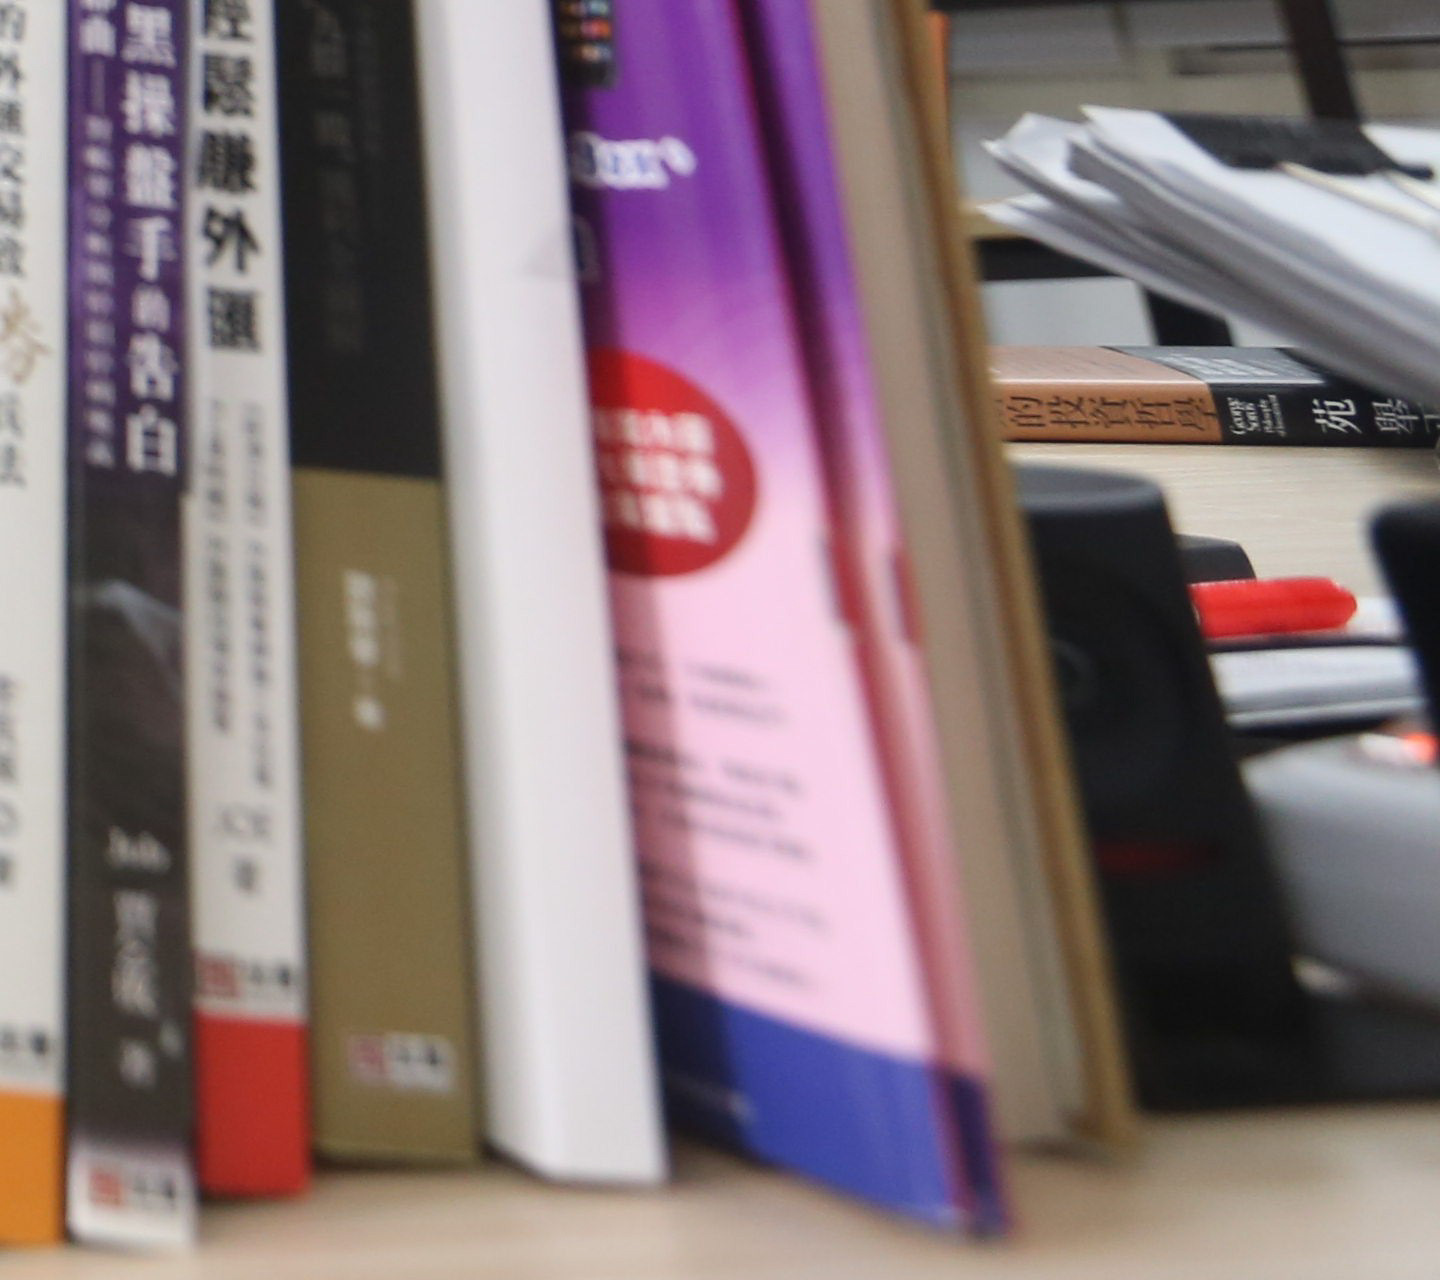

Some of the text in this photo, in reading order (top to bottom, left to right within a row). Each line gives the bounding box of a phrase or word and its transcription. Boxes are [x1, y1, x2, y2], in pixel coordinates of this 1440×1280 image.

[994, 394, 1217, 433] 的投資哲學
